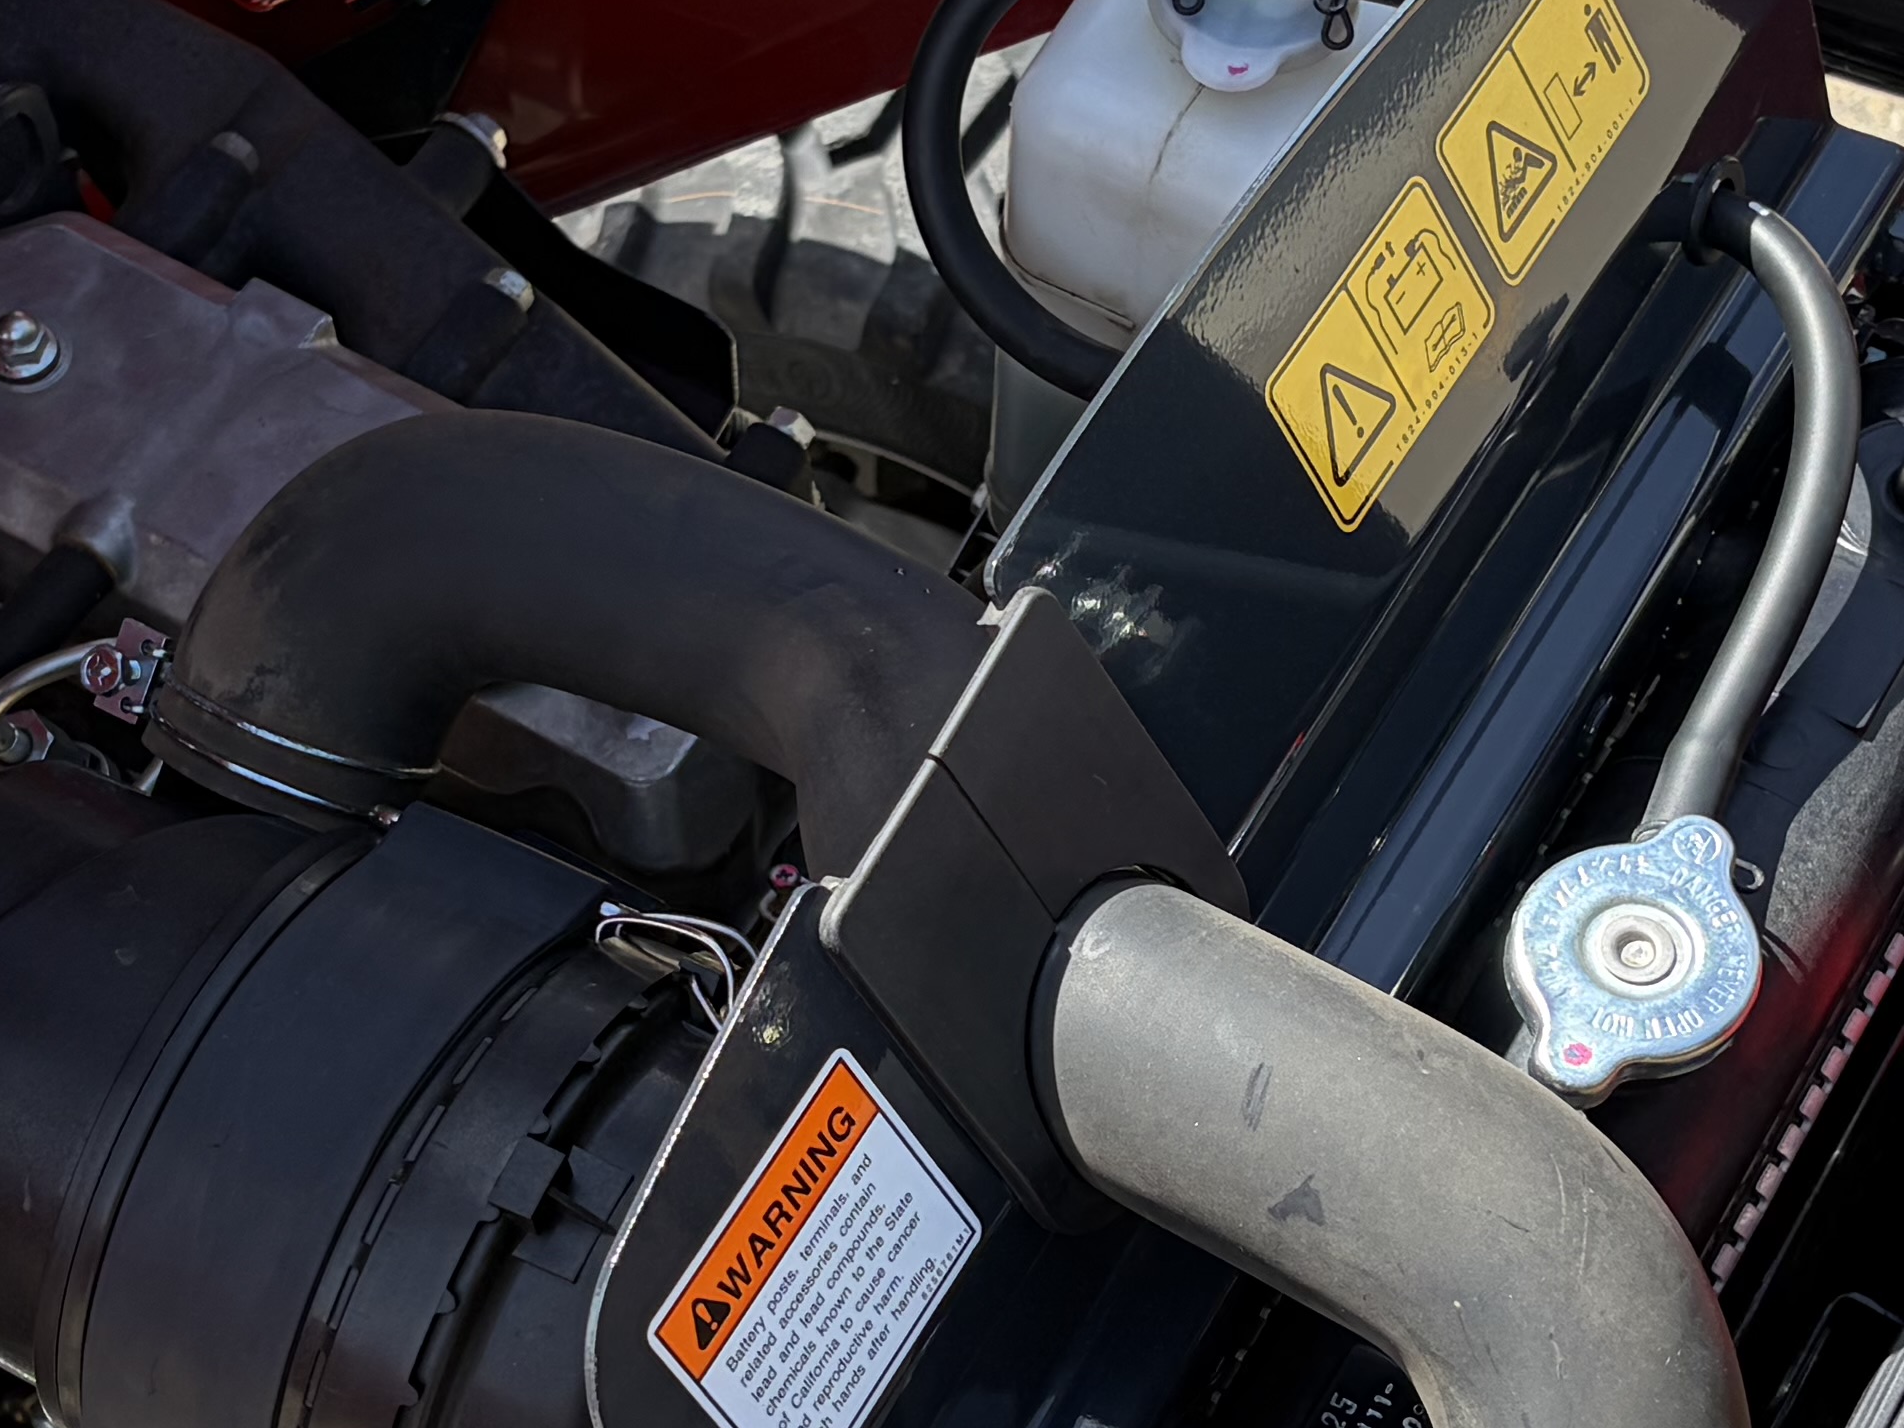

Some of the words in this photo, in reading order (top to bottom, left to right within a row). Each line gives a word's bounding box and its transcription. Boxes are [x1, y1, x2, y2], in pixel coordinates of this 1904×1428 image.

[1395, 332, 1478, 452] 1824-904-013-1
[715, 1105, 856, 1300] WARNING
[724, 1315, 767, 1373] Battery
[850, 1152, 872, 1186] and
[739, 1330, 778, 1388] related
[777, 1240, 838, 1330] accessories
[838, 1181, 877, 1237] contain
[749, 1364, 778, 1403] lead
[777, 1328, 801, 1364] and
[798, 1290, 826, 1329] lead
[765, 1339, 817, 1417] chemicals
[814, 1285, 852, 1337] known
[850, 1264, 866, 1283] to
[864, 1235, 885, 1261] the
[883, 1191, 913, 1232] State
[790, 1337, 841, 1409] California
[838, 1316, 854, 1334] to
[854, 1266, 886, 1313] cause
[886, 1210, 921, 1263] cancer
[811, 1318, 874, 1412] reproductive
[871, 1274, 905, 1316] harm.
[830, 1363, 866, 1413] hands
[866, 1322, 890, 1361] after
[889, 1256, 937, 1321] handling.
